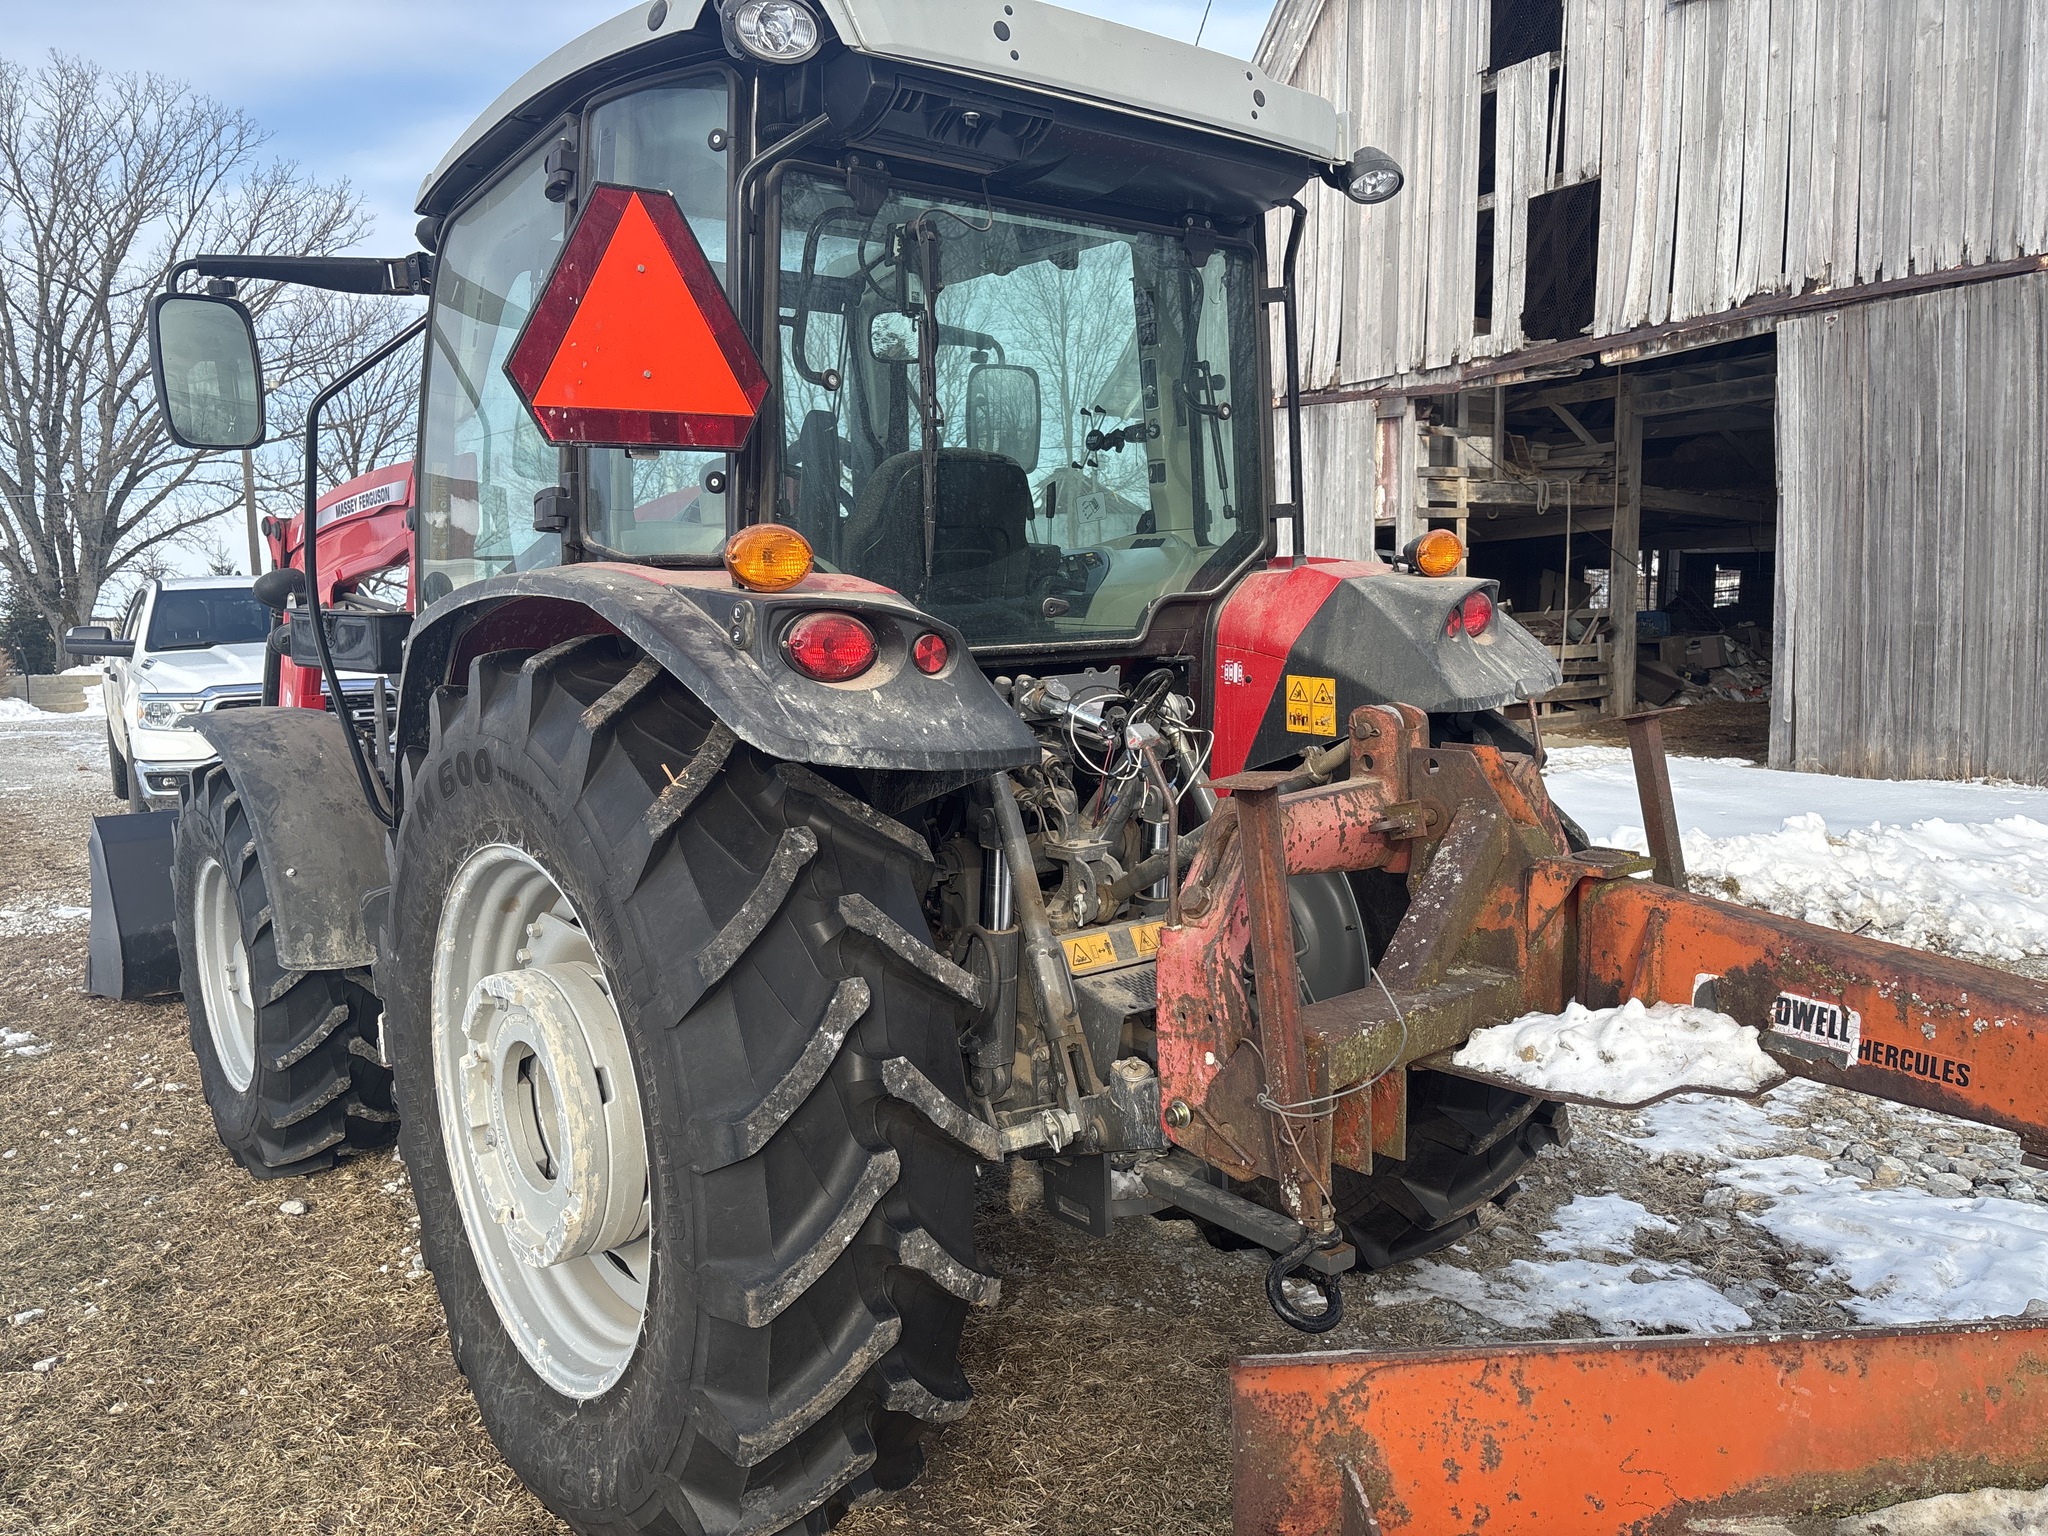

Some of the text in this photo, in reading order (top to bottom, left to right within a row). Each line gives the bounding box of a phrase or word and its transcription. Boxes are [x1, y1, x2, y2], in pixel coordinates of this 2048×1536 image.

[335, 486, 390, 518] MASSEY FERGUSON
[1858, 1038, 1971, 1087] HERCULES
